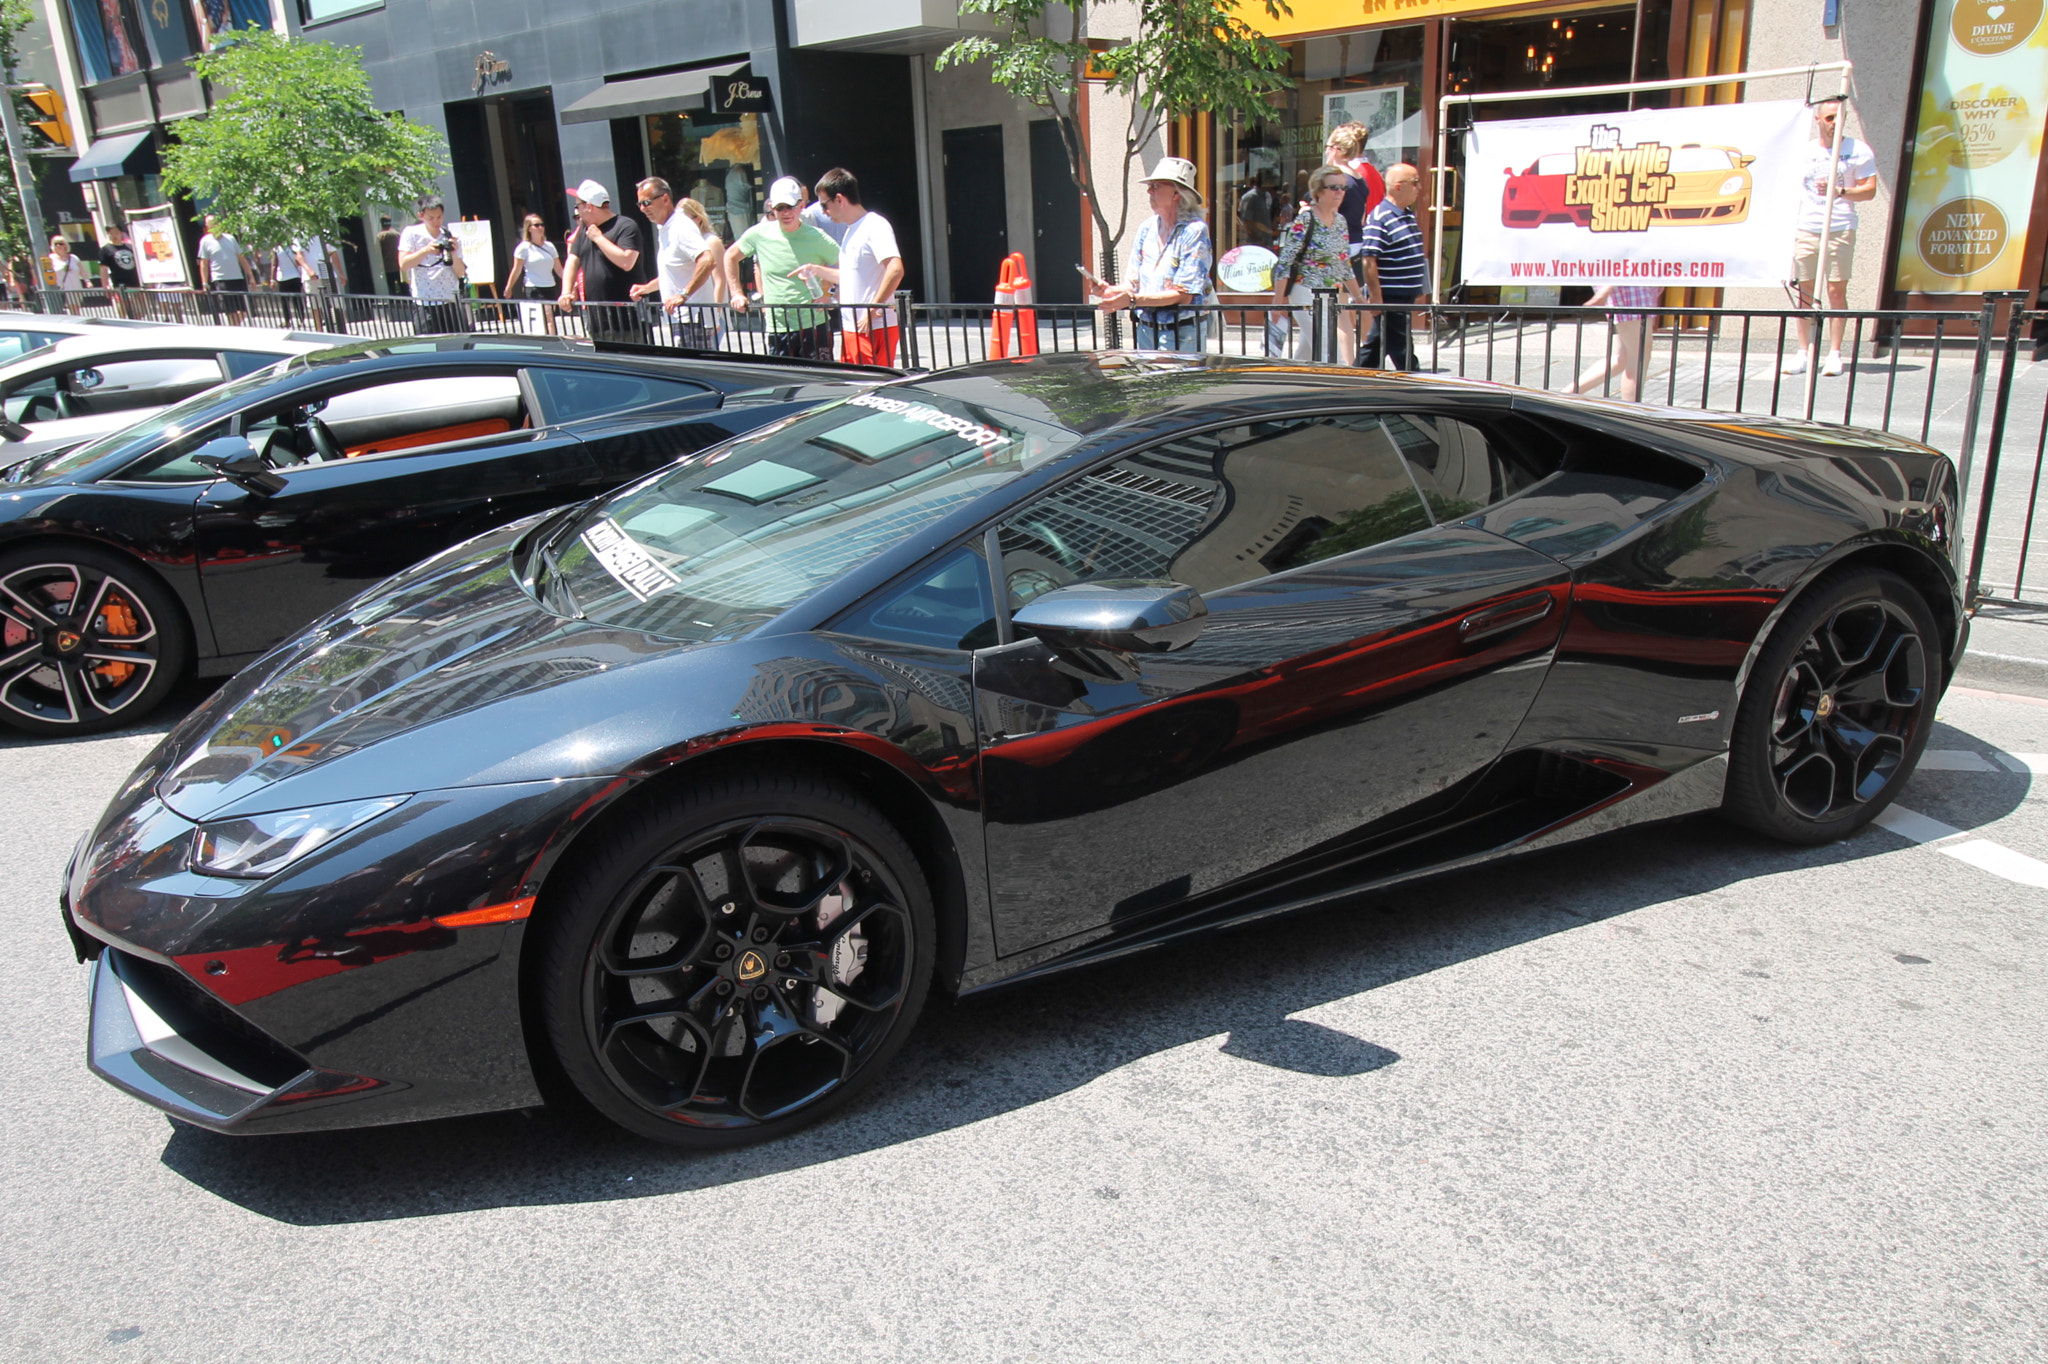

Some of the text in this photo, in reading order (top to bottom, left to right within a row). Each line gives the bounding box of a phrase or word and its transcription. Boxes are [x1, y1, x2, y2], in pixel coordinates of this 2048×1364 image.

[1971, 22, 2015, 37] DIVINE
[1949, 97, 2017, 111] DISCOVER
[1964, 109, 1999, 121] WHY
[1590, 124, 1621, 150] the
[1960, 122, 1996, 143] 95%
[1576, 142, 1672, 177] Yorkville
[1565, 173, 1675, 206] Exotic Car
[1590, 202, 1652, 232] Show
[1945, 212, 1986, 229] NEW
[1927, 228, 1998, 242] ADVANCED
[1929, 242, 1992, 255] FORMULA
[1221, 264, 1243, 280] Mini
[1510, 258, 1725, 278] www.YorkvilleExotics.com
[897, 405, 1010, 450] AUTOSPORT
[621, 560, 676, 598] RALLY
